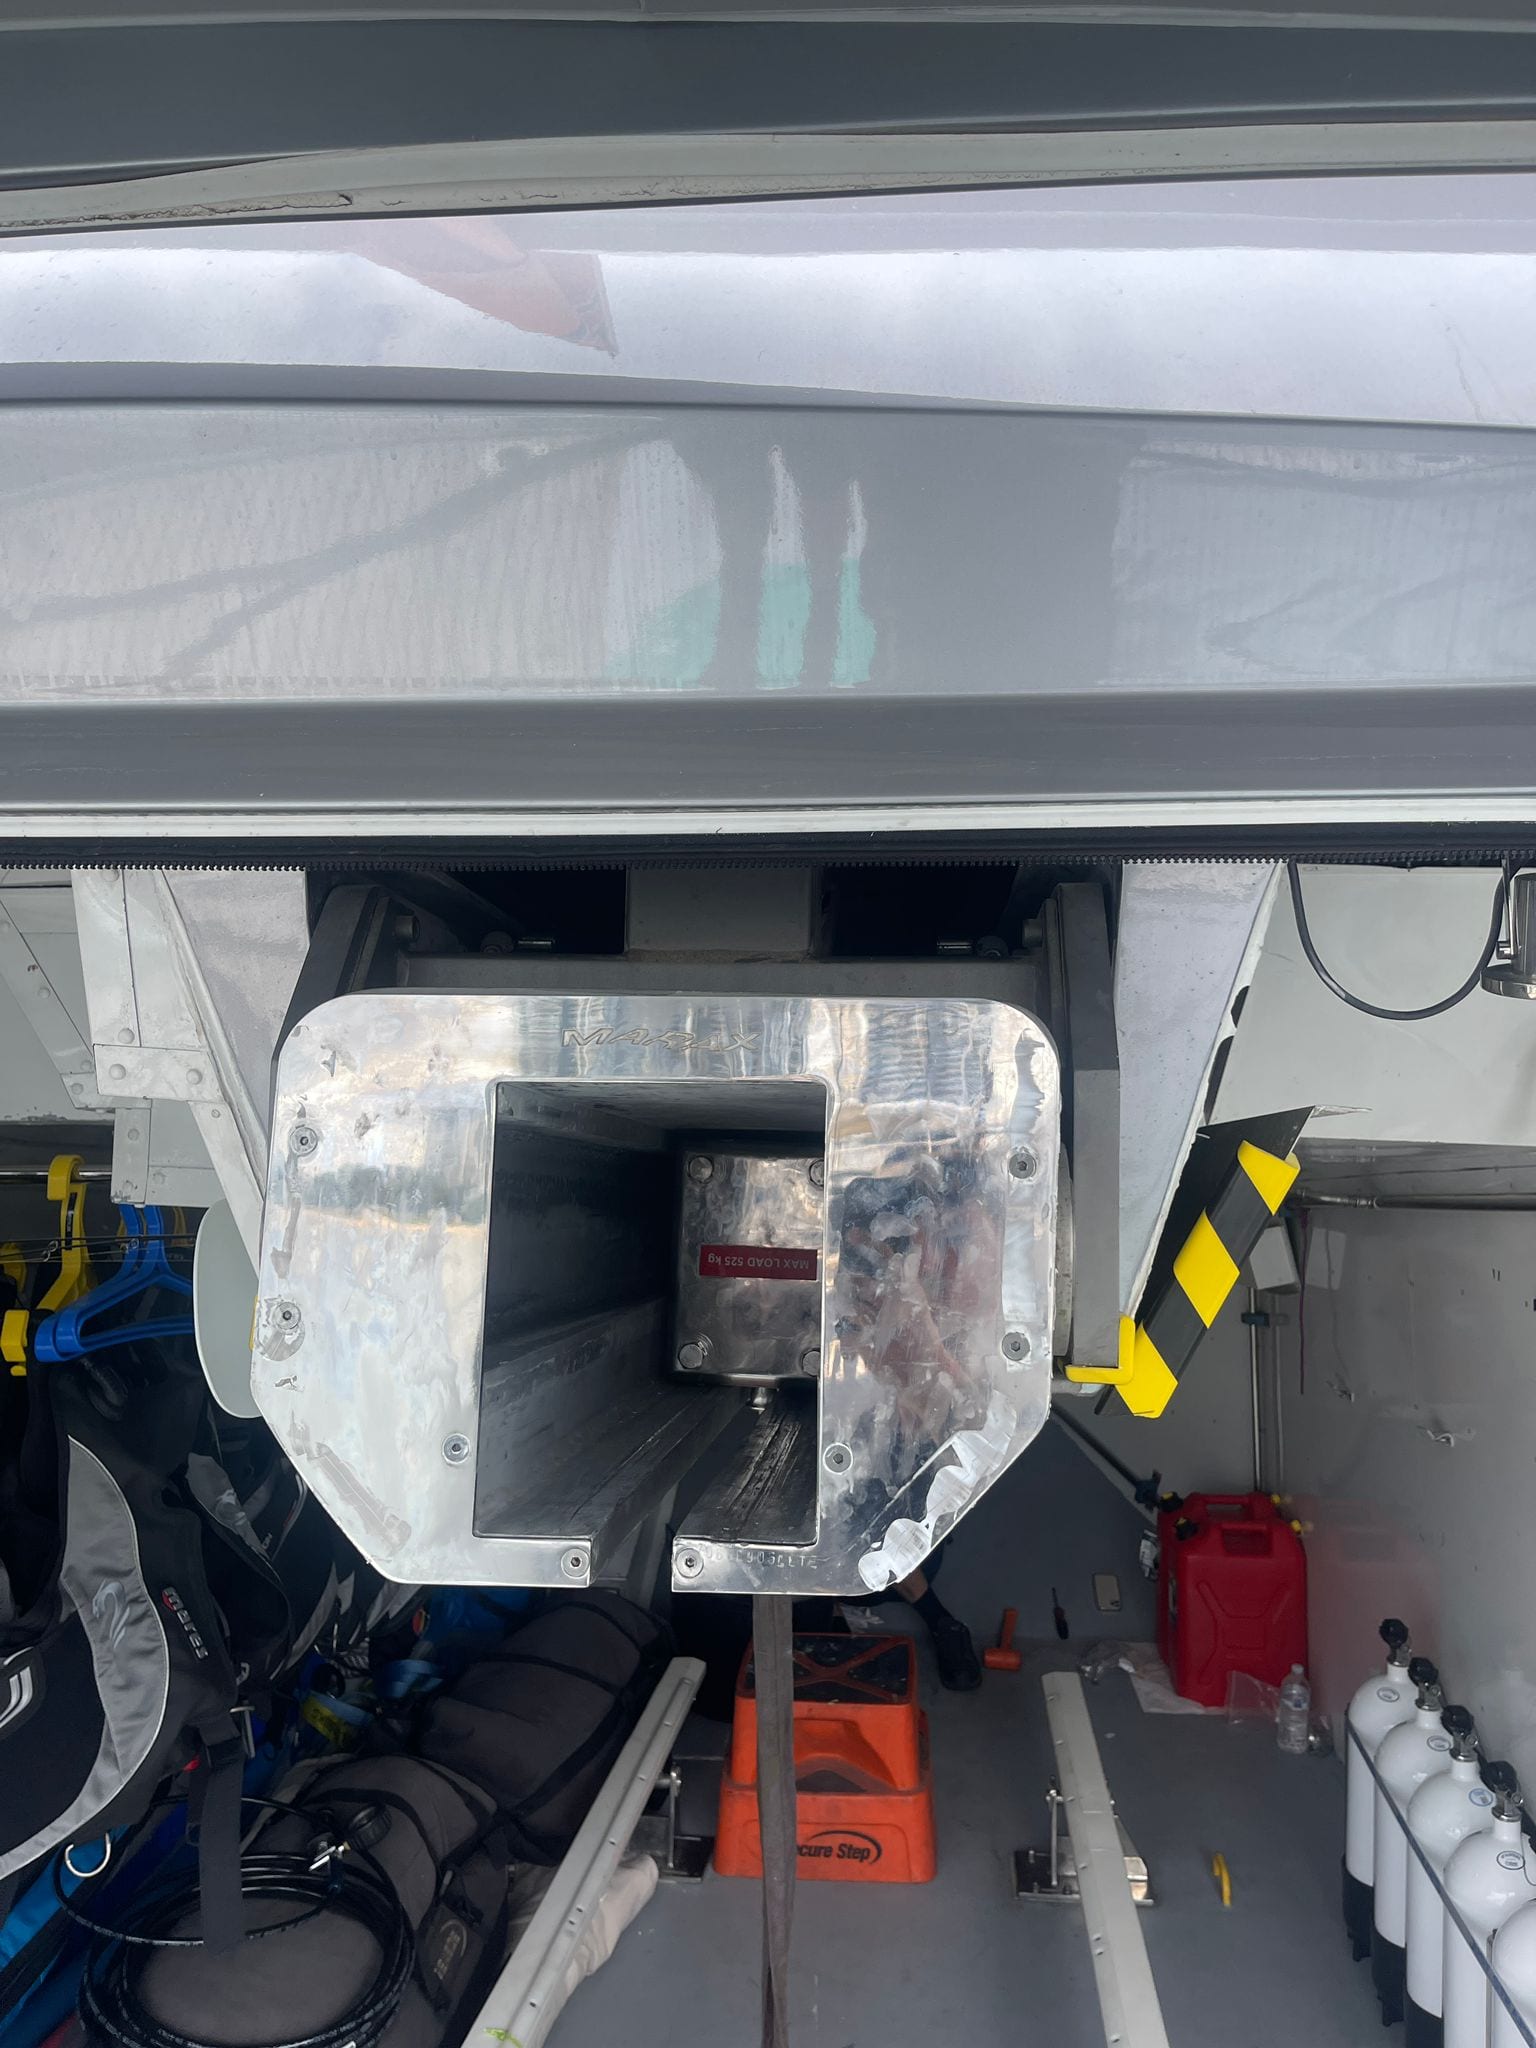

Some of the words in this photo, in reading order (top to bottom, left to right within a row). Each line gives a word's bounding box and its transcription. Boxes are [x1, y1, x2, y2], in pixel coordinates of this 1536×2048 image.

[708, 1253, 721, 1264] kg
[724, 1256, 743, 1267] 525
[747, 1257, 780, 1268] LOAD
[783, 1259, 809, 1269] MAX
[161, 1586, 209, 1659] mares
[796, 1844, 833, 1858] cure
[836, 1843, 870, 1863] Step
